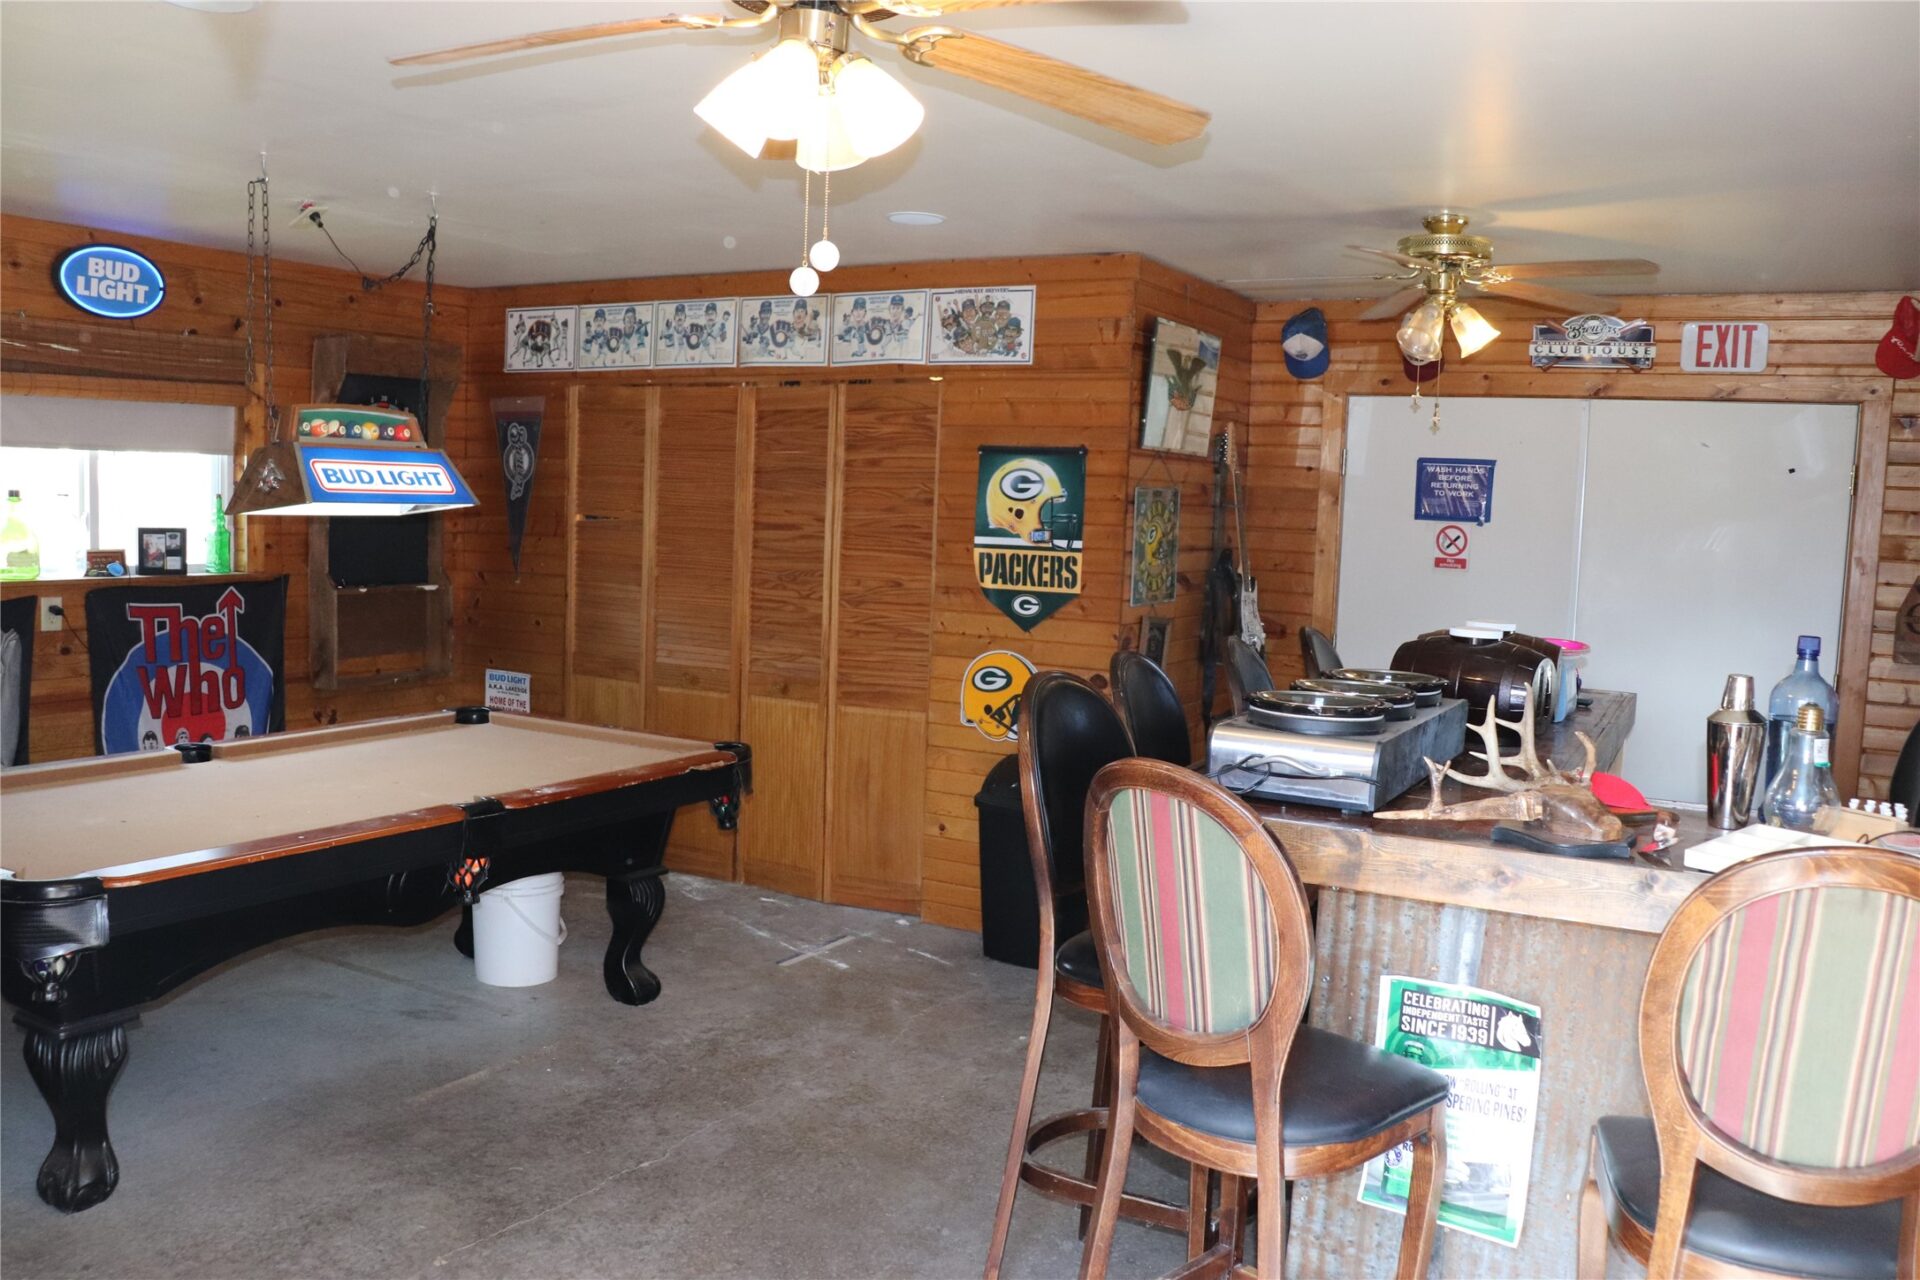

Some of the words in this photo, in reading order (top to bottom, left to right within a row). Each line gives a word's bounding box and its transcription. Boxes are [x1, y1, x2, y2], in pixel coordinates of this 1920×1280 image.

[87, 257, 141, 283] BUD
[76, 275, 149, 304] LIGHT
[1534, 345, 1651, 355] CLUBHOUSE
[1695, 325, 1758, 368] EXIT
[321, 468, 374, 485] BUD
[376, 470, 442, 487] LIGHT
[1431, 482, 1479, 490] RETURNING
[1438, 474, 1472, 482] BEFORE
[1434, 489, 1445, 497] TO
[1448, 490, 1474, 498] WORK
[979, 551, 1078, 590] PACKERS
[127, 603, 227, 664] The
[489, 673, 506, 682] BUD
[507, 675, 527, 685] LIGHT
[136, 664, 246, 719] Who
[489, 696, 506, 706] HOME
[508, 699, 515, 707] OF
[517, 700, 527, 709] THE
[1403, 990, 1490, 1019] CELEBRATING
[1402, 1005, 1461, 1023] INDEPENDENT
[1462, 1013, 1488, 1029] TASTE
[1401, 1016, 1448, 1038] SINCE
[1450, 1024, 1488, 1045] 1939
[1507, 1087, 1518, 1101] AT
[1493, 1102, 1528, 1124] PINES!
